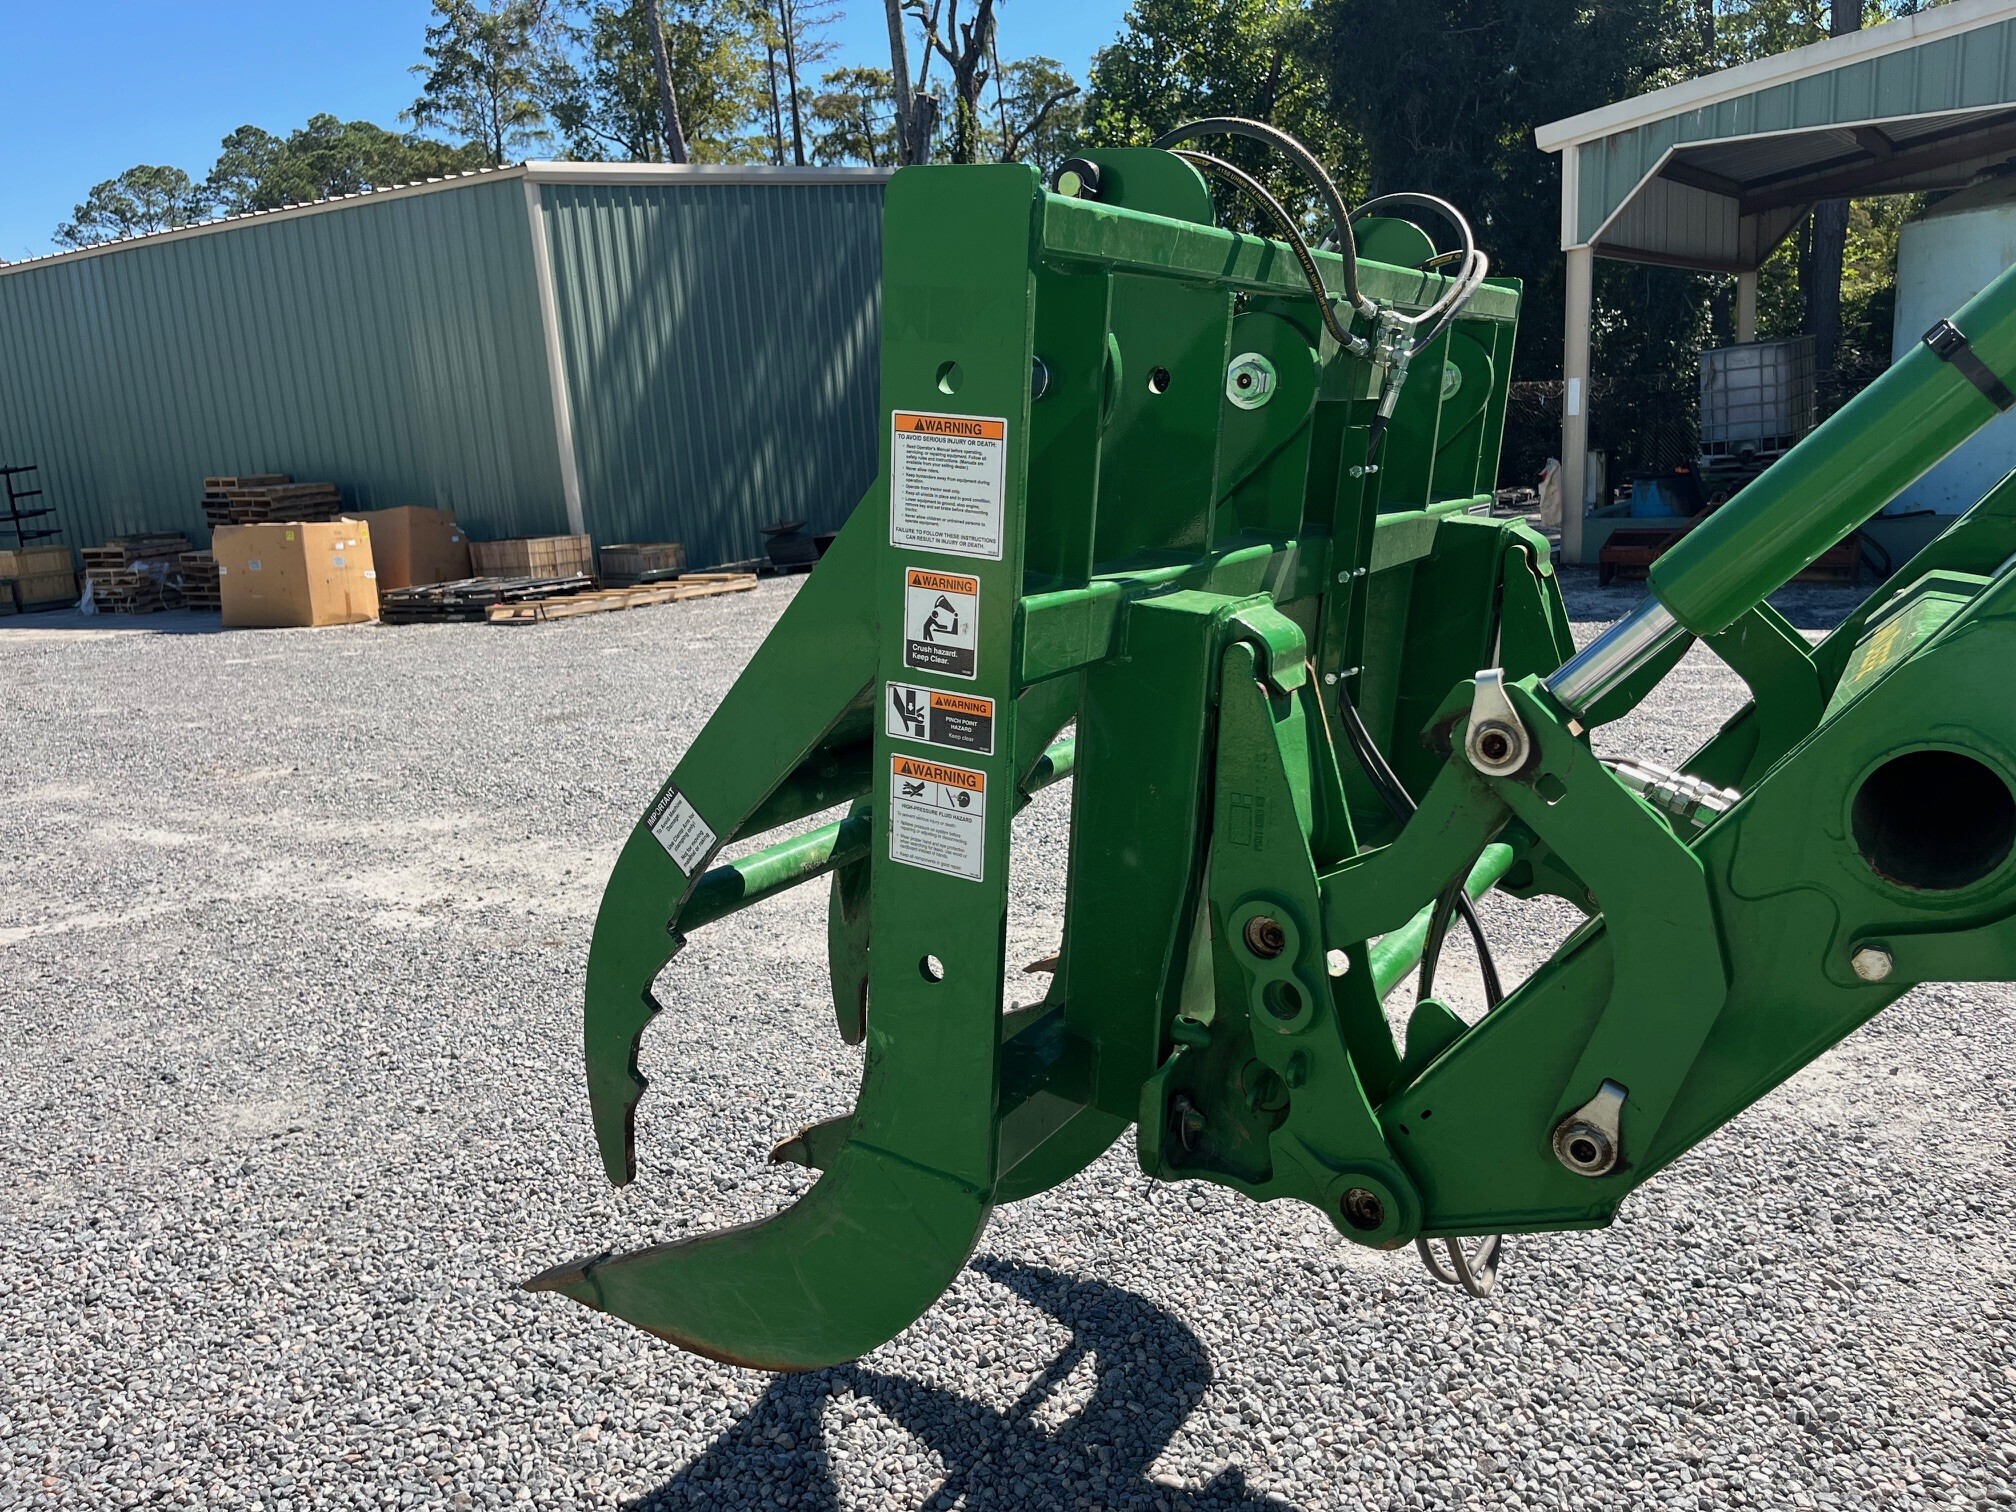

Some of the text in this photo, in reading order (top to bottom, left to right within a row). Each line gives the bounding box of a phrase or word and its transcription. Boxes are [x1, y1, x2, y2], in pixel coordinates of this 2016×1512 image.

[1216, 166, 1231, 177] A150
[1254, 192, 1270, 207] INCH
[925, 420, 982, 436] WARNING
[961, 535, 996, 544] INSTRUCTIONS
[923, 576, 972, 592] WARNING
[913, 644, 958, 658] Crush hazard.
[913, 652, 949, 665] Keep Clear.
[944, 698, 986, 713] WARNING
[946, 716, 978, 727] PINCH POINT
[951, 724, 972, 733] HAZARD
[949, 733, 961, 741] Keep
[913, 763, 976, 787] WARNING
[647, 786, 675, 827] IMPORTANT
[902, 803, 972, 823] HIGH-PRESSURE FLUID HAZARD
[657, 798, 682, 835] To Avoid Machine
[673, 827, 684, 842] Clamp
[682, 818, 690, 828] Arm
[674, 831, 689, 852] clamping
